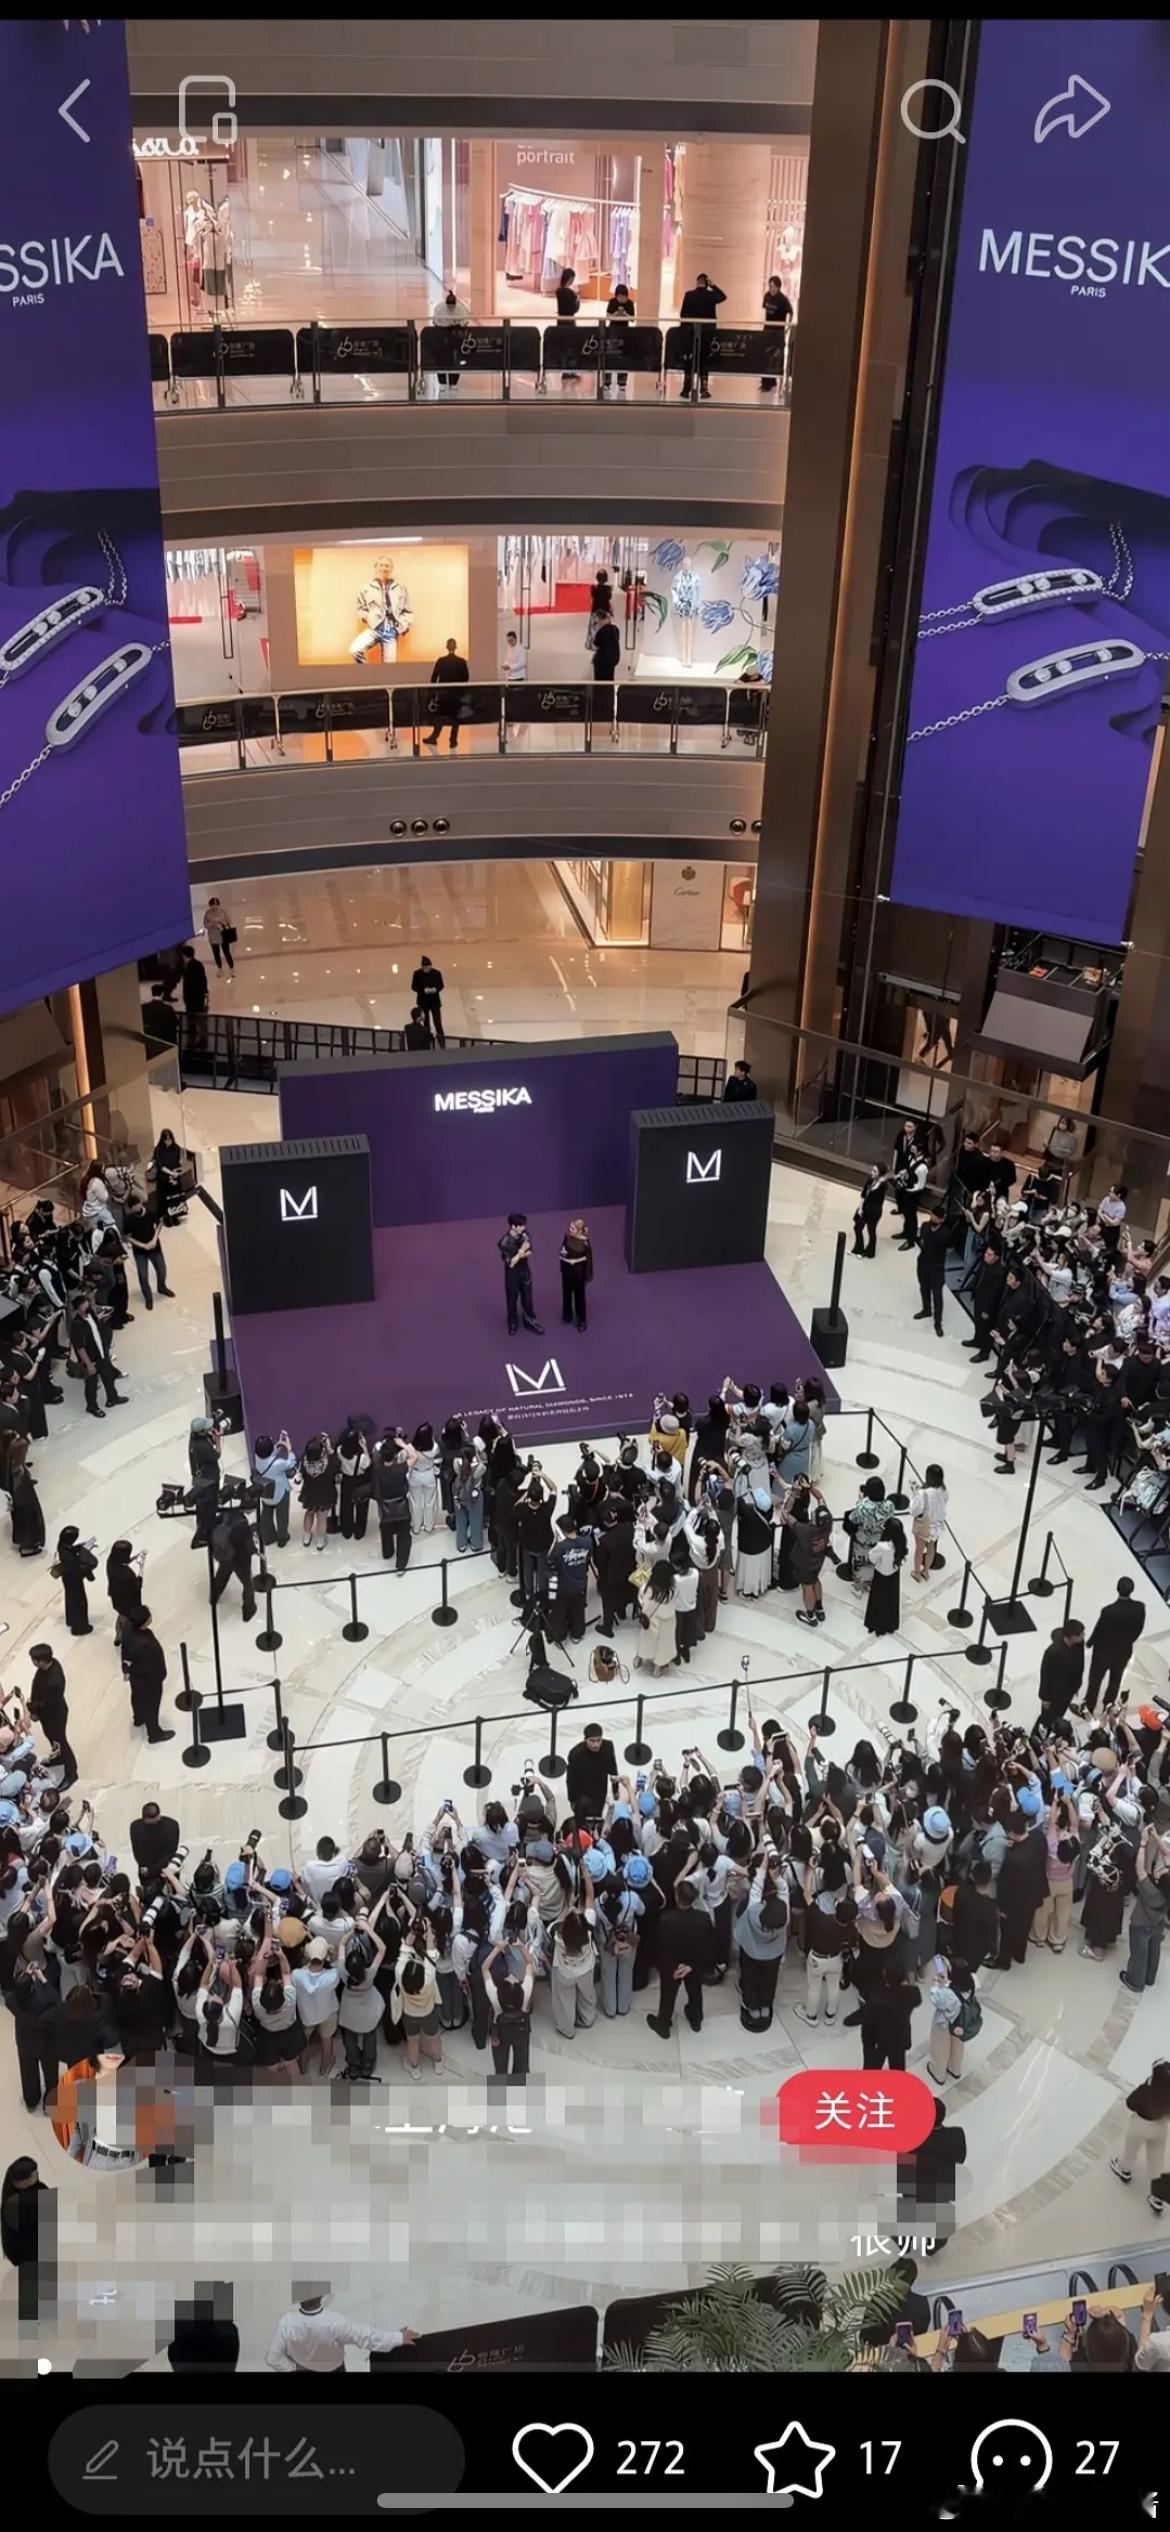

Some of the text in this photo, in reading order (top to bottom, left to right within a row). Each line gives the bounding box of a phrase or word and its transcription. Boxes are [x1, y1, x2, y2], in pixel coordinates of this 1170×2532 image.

[516, 149, 575, 167] portrait
[1070, 285, 1107, 298] PARIS
[12, 293, 45, 307] PARIS
[434, 1086, 532, 1112] MESSIKA
